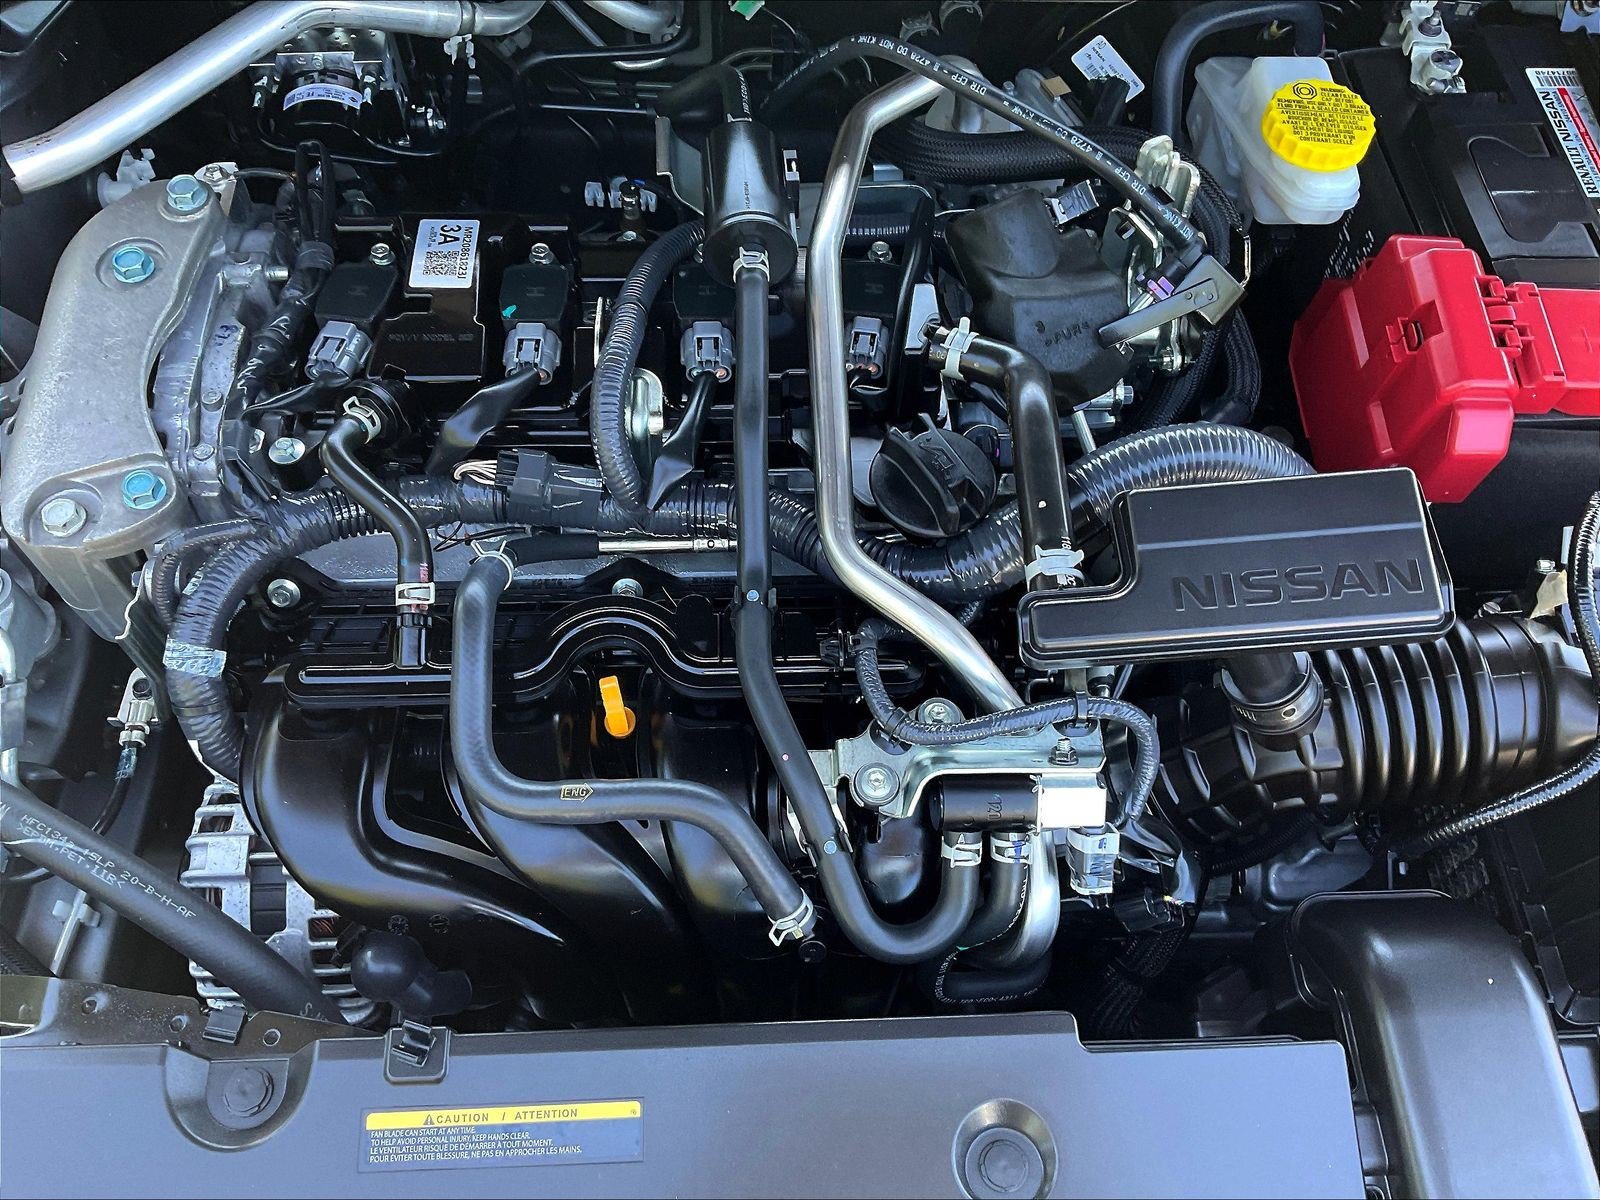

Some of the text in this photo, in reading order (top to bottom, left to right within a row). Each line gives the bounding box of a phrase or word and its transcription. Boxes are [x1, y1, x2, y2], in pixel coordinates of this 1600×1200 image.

[878, 38, 894, 50] NOT
[1539, 91, 1574, 142] NISSAN
[1070, 134, 1093, 153] 4728
[1566, 146, 1600, 193] RENAULT
[438, 224, 462, 246] 3A
[458, 226, 474, 278] MR20861823J
[1172, 558, 1424, 612] NISSAN
[564, 788, 586, 797] ENG
[436, 1113, 488, 1124] CAUTION
[515, 1108, 578, 1120] ATTENTION
[371, 1130, 384, 1138] FAN
[384, 1130, 405, 1138] BLADE
[406, 1129, 418, 1137] CAN
[417, 1136, 448, 1144] PERSONAL
[370, 1155, 388, 1163] POUR
[413, 1152, 435, 1160] TOUTE
[482, 1150, 494, 1158] PAS
[494, 1149, 504, 1157] EN
[506, 1148, 545, 1156] APPROCHER
[546, 1146, 558, 1154] LES
[558, 1145, 582, 1154] MAINS.
[379, 1145, 423, 1154] VENTILATEUR
[424, 1144, 448, 1152] RISQUE
[460, 1141, 496, 1150] DÉMARRER
[522, 1138, 554, 1147] MOMENT.
